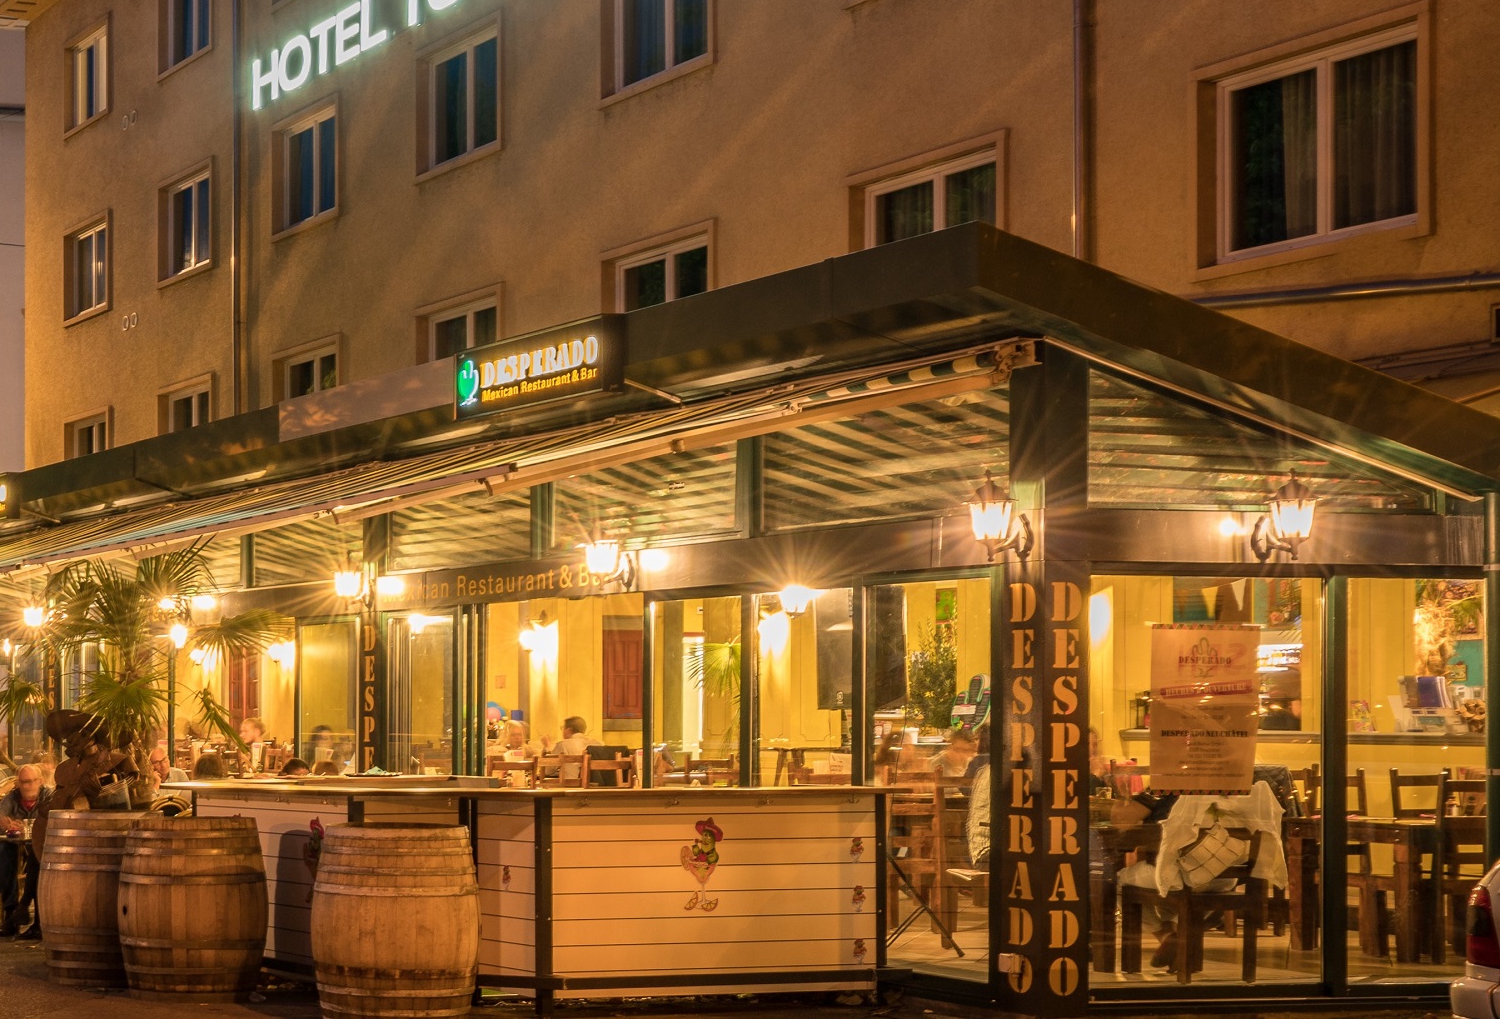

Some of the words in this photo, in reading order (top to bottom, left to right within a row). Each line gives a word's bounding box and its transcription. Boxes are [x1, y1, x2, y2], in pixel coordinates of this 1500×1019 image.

[480, 336, 599, 388] DESPERADO
[482, 386, 518, 403] Mexican
[520, 373, 570, 394] Restaurant
[572, 370, 580, 382] &
[581, 367, 598, 380] Bar
[457, 568, 554, 596] Restaurant
[560, 564, 573, 588] &
[1178, 655, 1232, 665] DESPERADO
[1008, 582, 1037, 994] DESPERADO
[1047, 582, 1082, 997] DESPERADO
